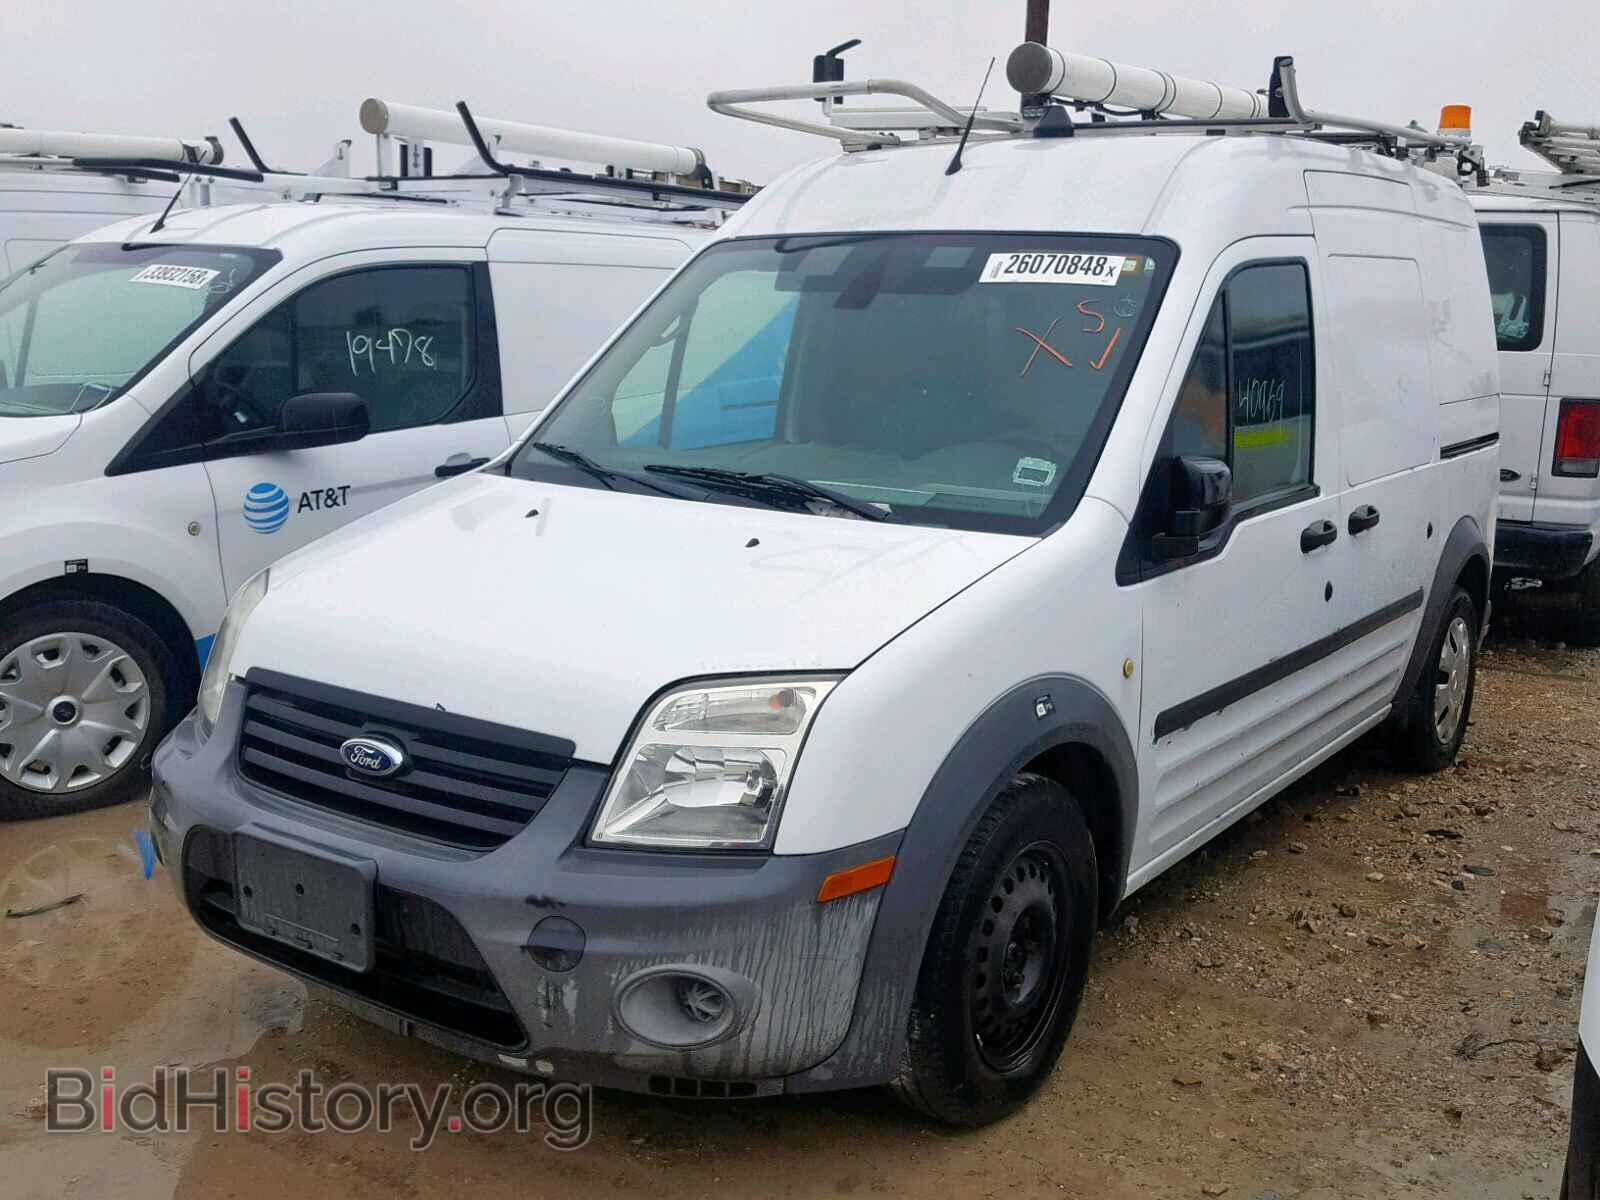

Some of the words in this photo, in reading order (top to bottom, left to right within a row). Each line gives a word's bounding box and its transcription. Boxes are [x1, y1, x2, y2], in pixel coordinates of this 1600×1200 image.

[1003, 254, 1108, 277] 26070848
[297, 485, 352, 514] AT&T
[351, 745, 383, 770] Ford
